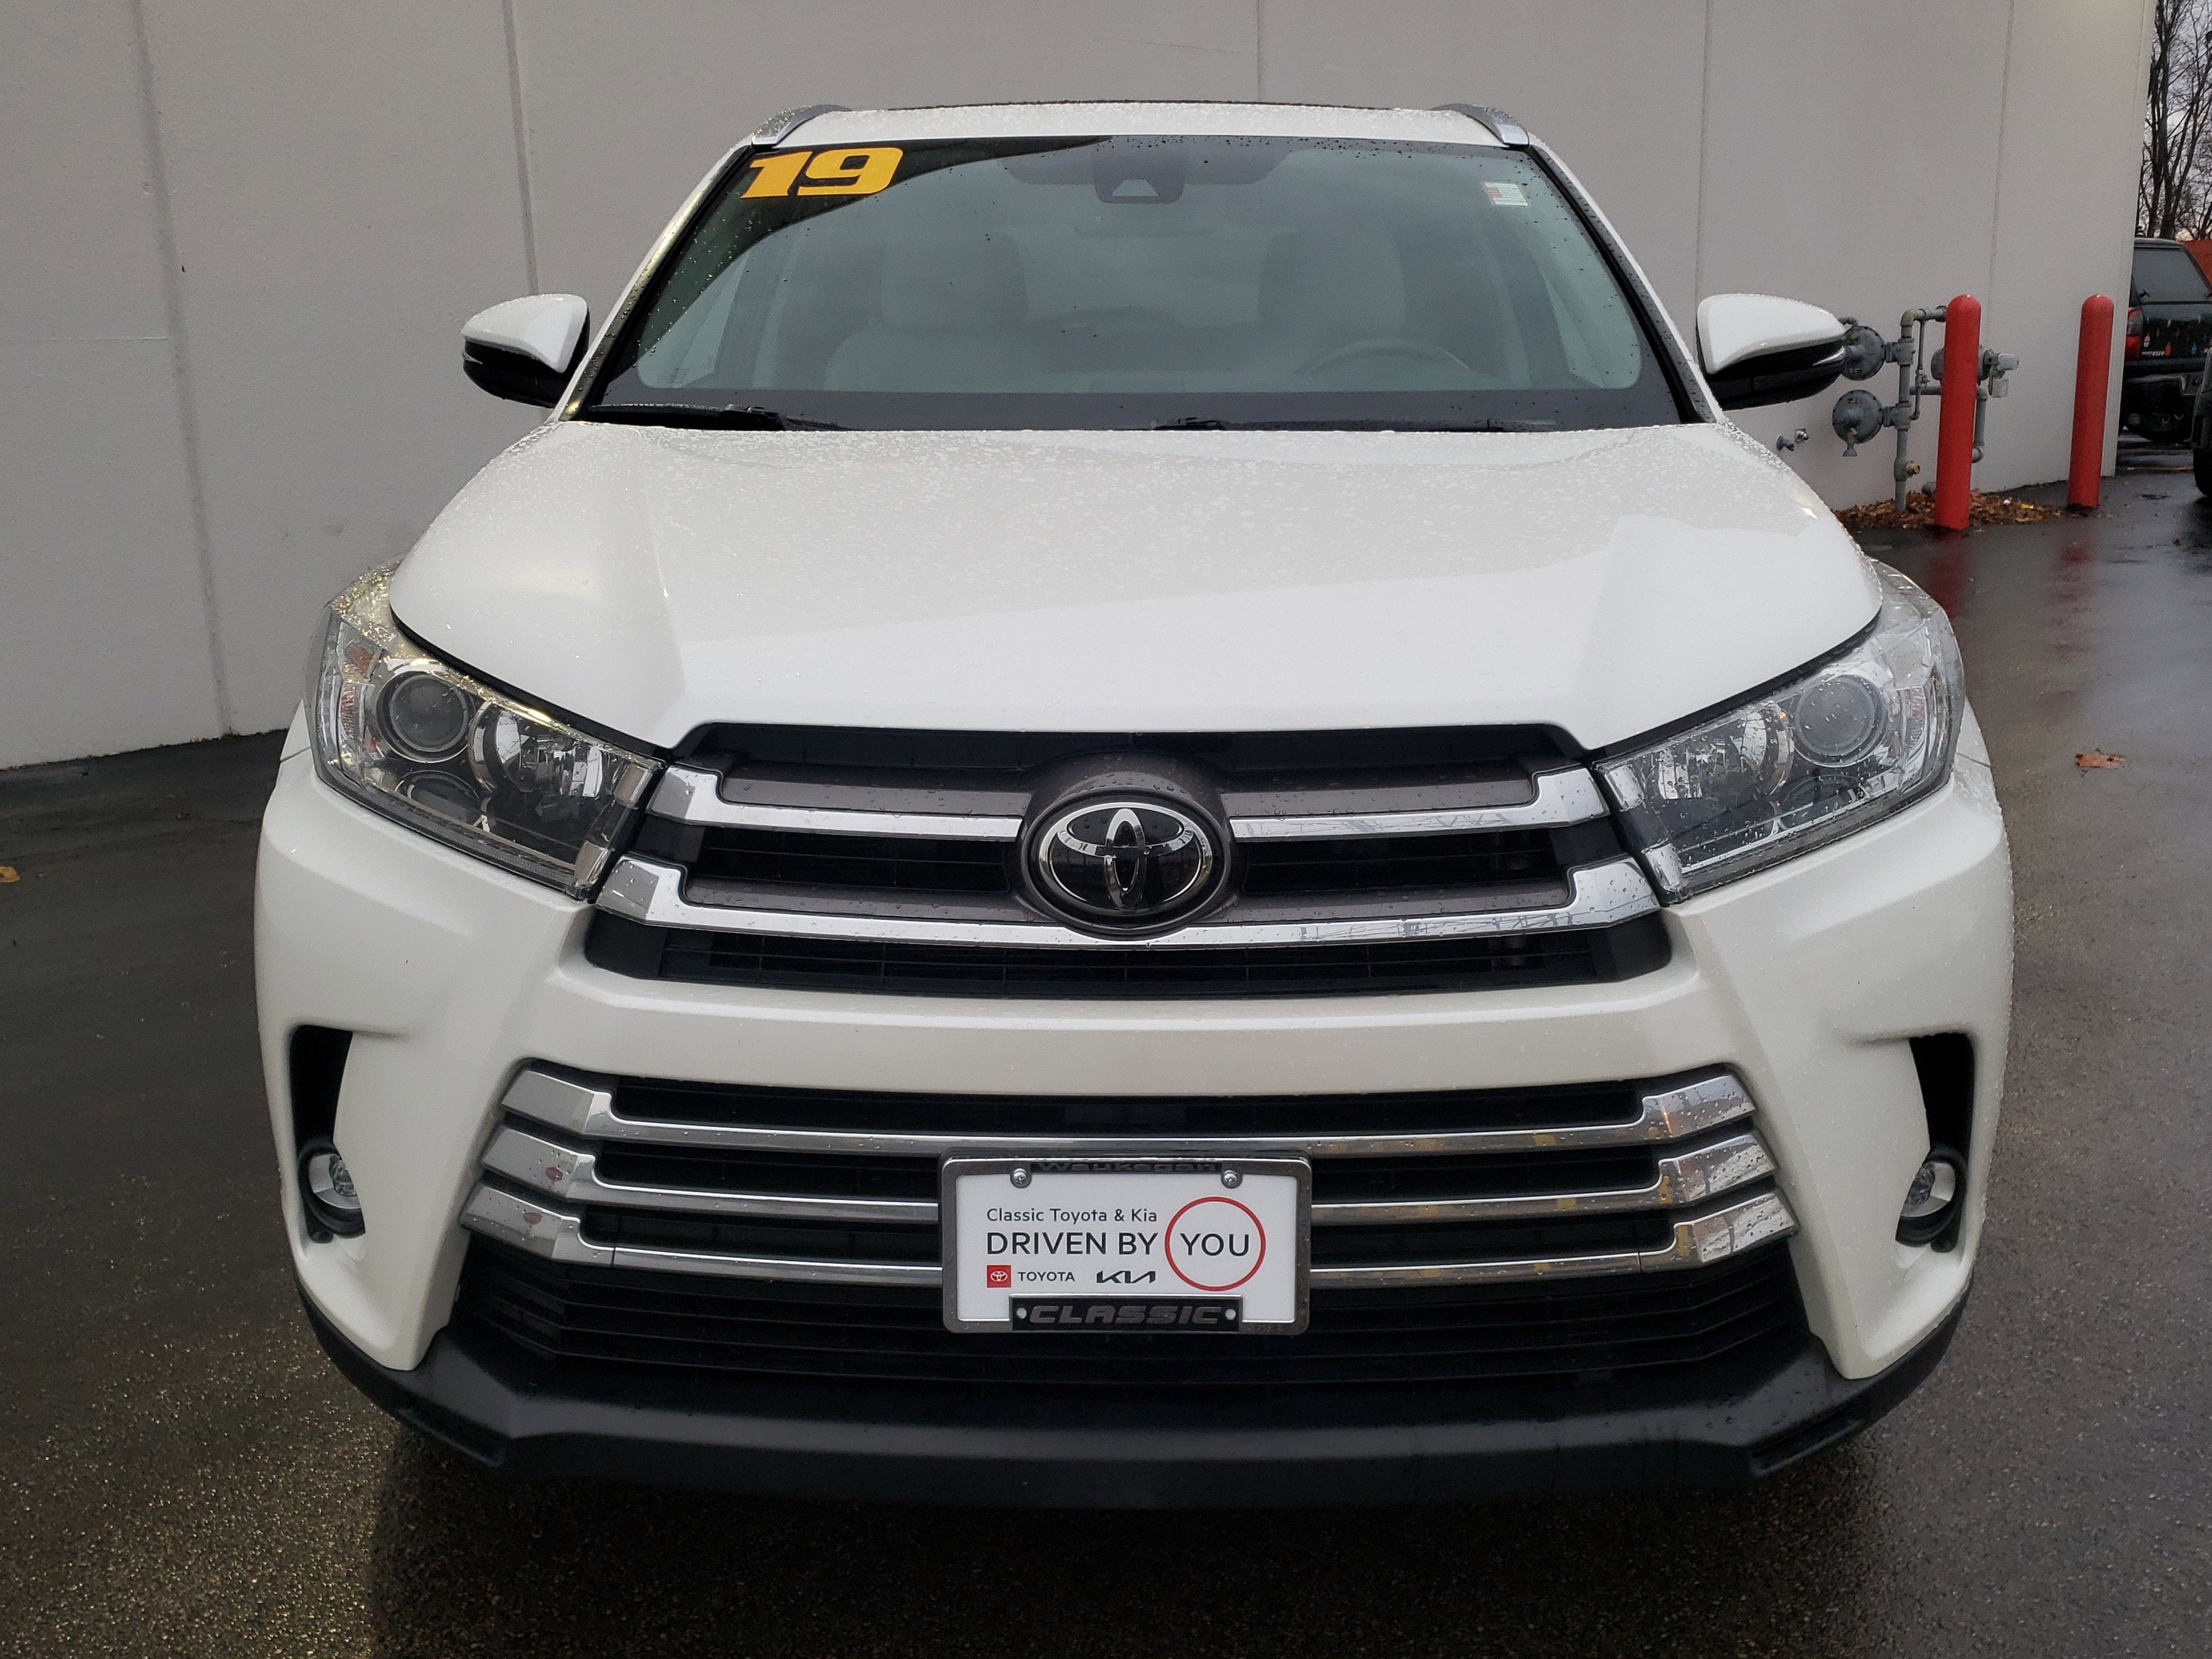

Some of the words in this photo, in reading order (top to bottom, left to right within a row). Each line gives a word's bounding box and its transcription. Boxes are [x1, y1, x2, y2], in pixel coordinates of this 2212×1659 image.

[740, 147, 904, 198] 19
[987, 1208, 1044, 1222] Classic
[1049, 1208, 1107, 1225] Toyota
[1115, 1208, 1125, 1222] &
[1131, 1208, 1158, 1222] Kia
[988, 1232, 1107, 1255] DRIVEN
[1119, 1232, 1159, 1255] BY
[1180, 1233, 1249, 1257] YOU
[1018, 1271, 1075, 1282] TOYOTA
[1029, 1305, 1222, 1325] CLASSIC
